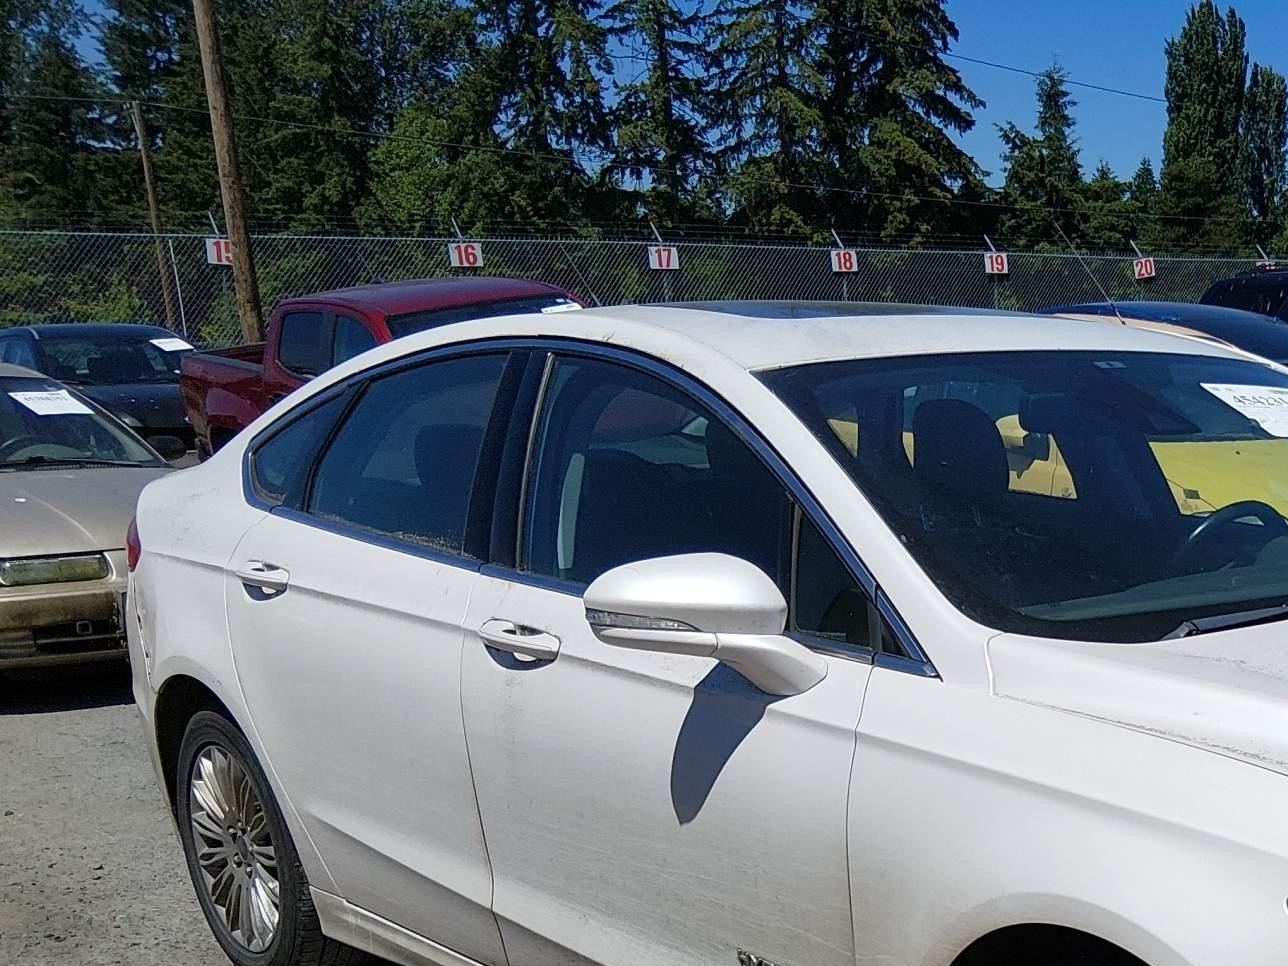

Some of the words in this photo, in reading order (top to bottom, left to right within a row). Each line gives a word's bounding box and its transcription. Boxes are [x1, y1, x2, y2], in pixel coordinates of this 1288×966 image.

[454, 244, 478, 266] 16
[655, 248, 672, 268] 17
[835, 251, 853, 271] 18
[988, 254, 1004, 273] 19
[1135, 258, 1153, 278] 20
